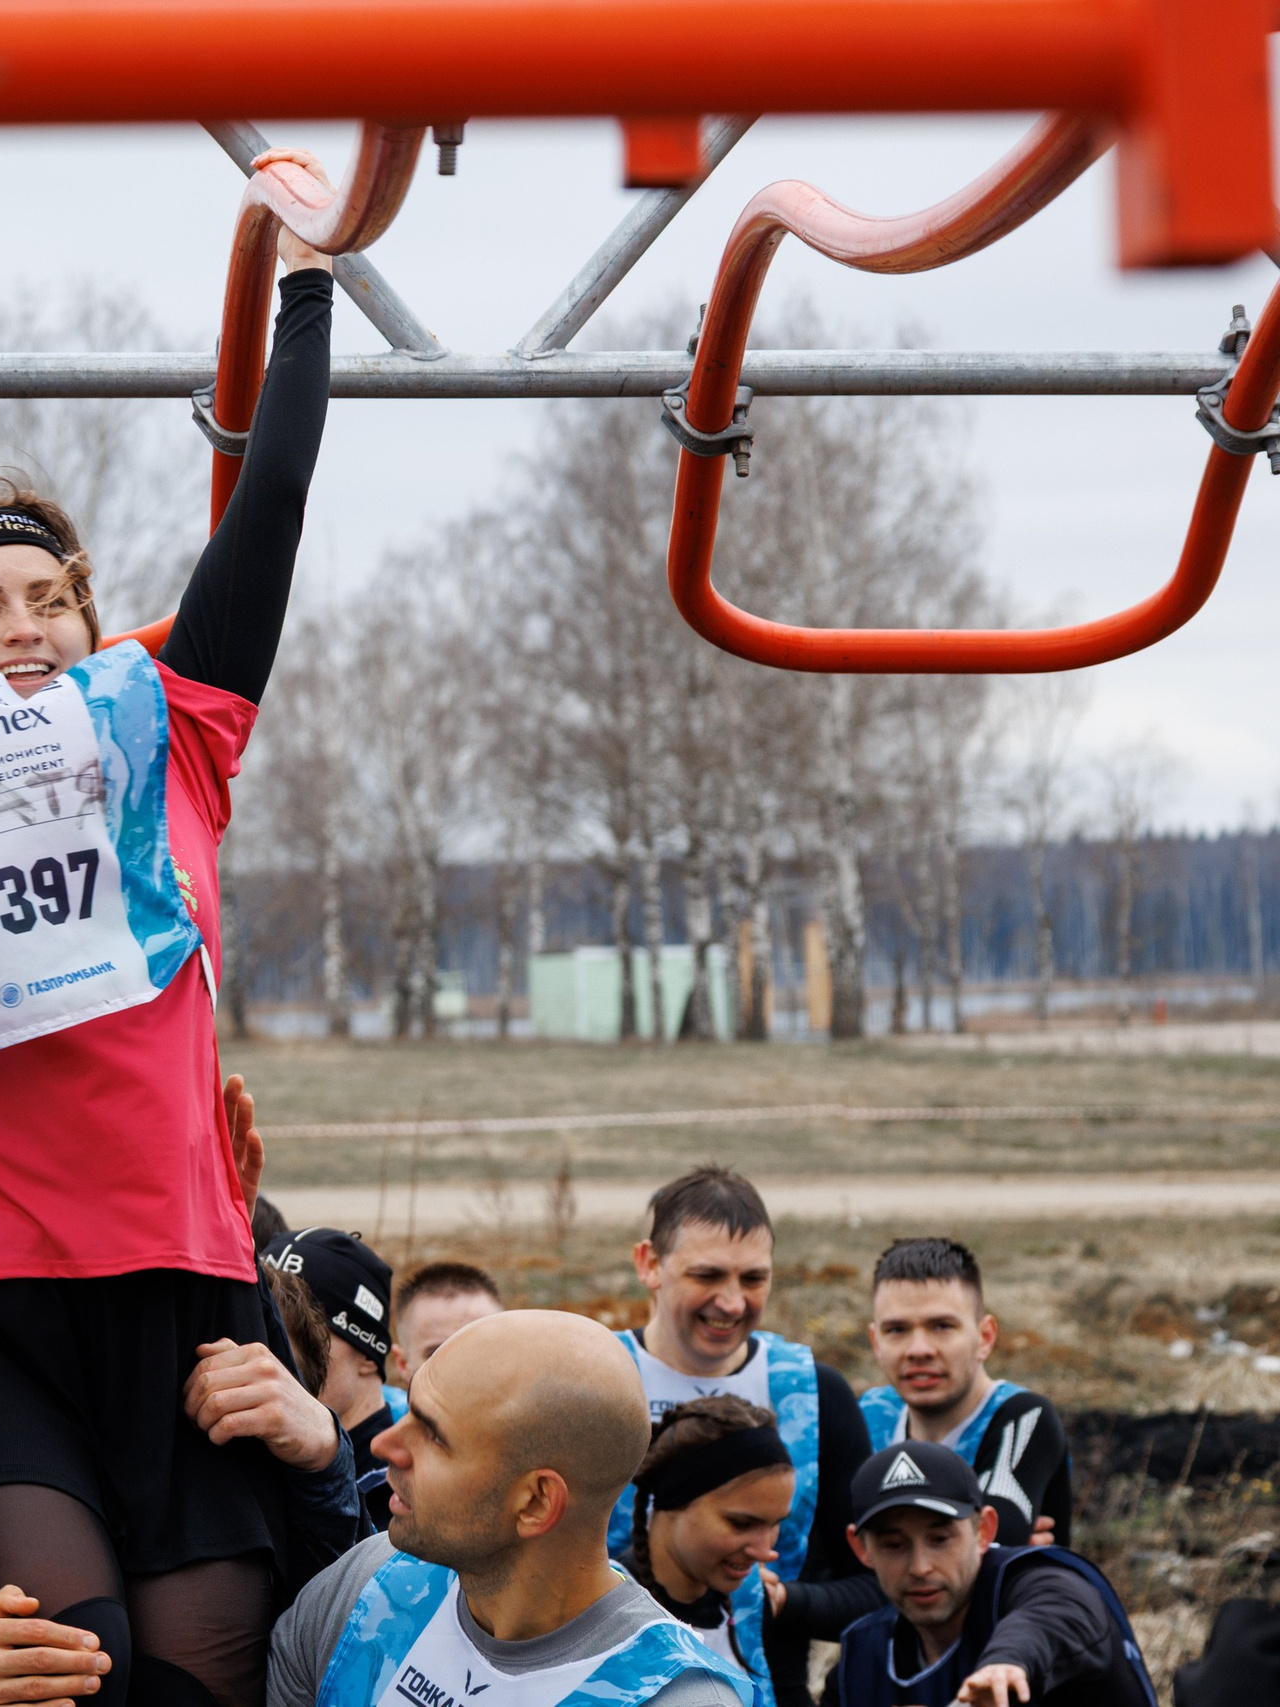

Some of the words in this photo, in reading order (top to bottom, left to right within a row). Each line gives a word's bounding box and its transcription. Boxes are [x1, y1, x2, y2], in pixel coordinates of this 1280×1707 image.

[27, 960, 117, 997] ГАЗПРОМБАНК
[260, 1243, 305, 1275] NB
[348, 1323, 389, 1355] odlo
[400, 1665, 456, 1707] ГОНКА
